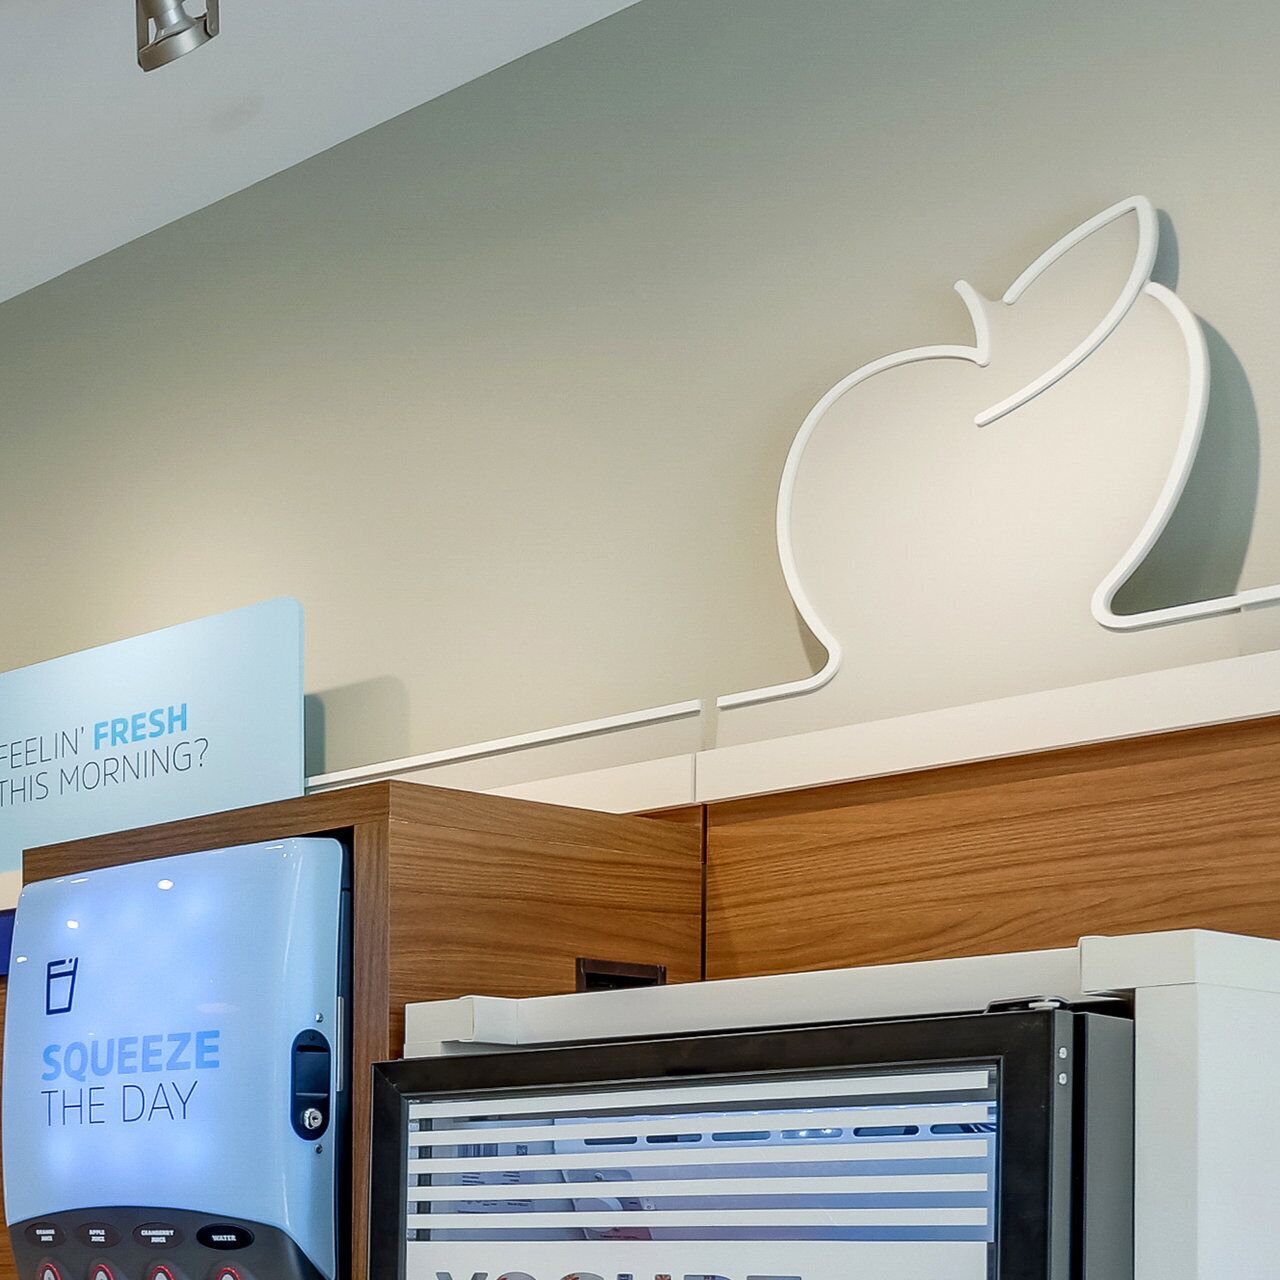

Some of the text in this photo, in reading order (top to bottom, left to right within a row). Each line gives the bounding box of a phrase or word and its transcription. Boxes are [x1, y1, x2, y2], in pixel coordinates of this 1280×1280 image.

[94, 703, 187, 751] FRESH
[60, 738, 209, 796] MORNING?
[41, 1030, 220, 1082] SQUEEZE
[41, 1080, 198, 1126] THE DAY
